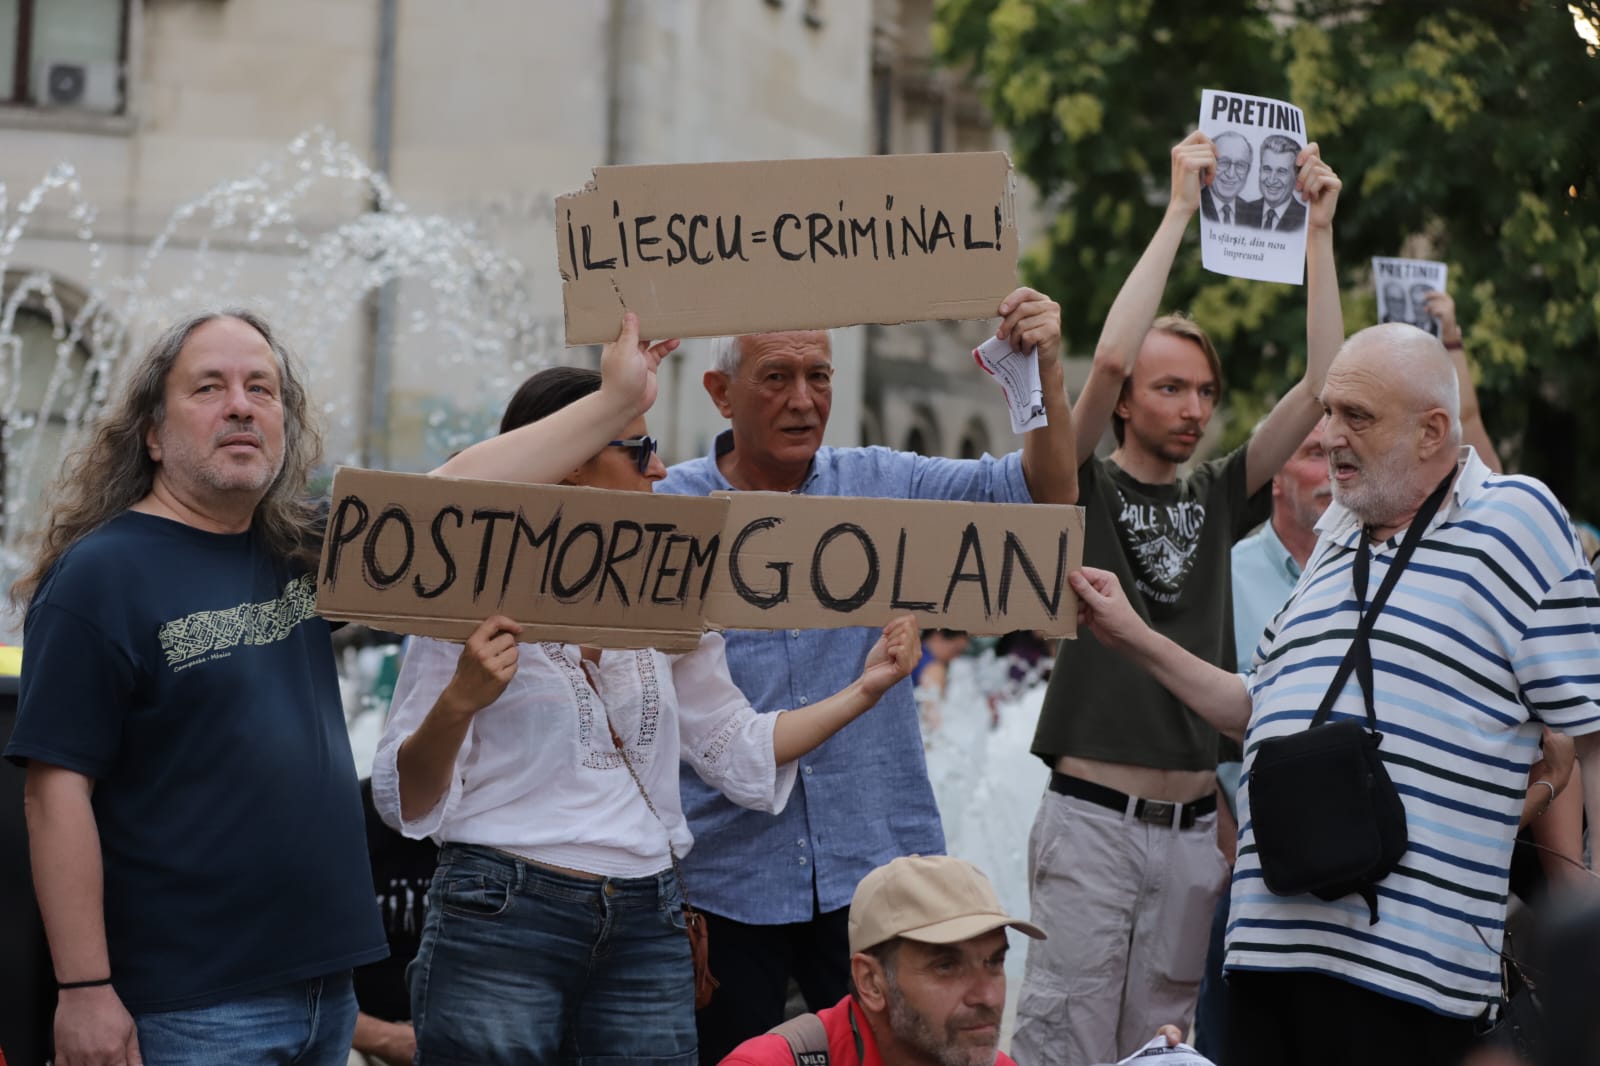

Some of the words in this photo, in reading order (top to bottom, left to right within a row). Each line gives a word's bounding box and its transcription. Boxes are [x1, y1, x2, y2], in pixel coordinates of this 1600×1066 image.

[1211, 95, 1301, 134] PRETINII
[1267, 240, 1286, 250] nou
[323, 494, 719, 611] POSTMORTEM
[728, 515, 1069, 621] GOLAN
[800, 1054, 826, 1065] WILD
